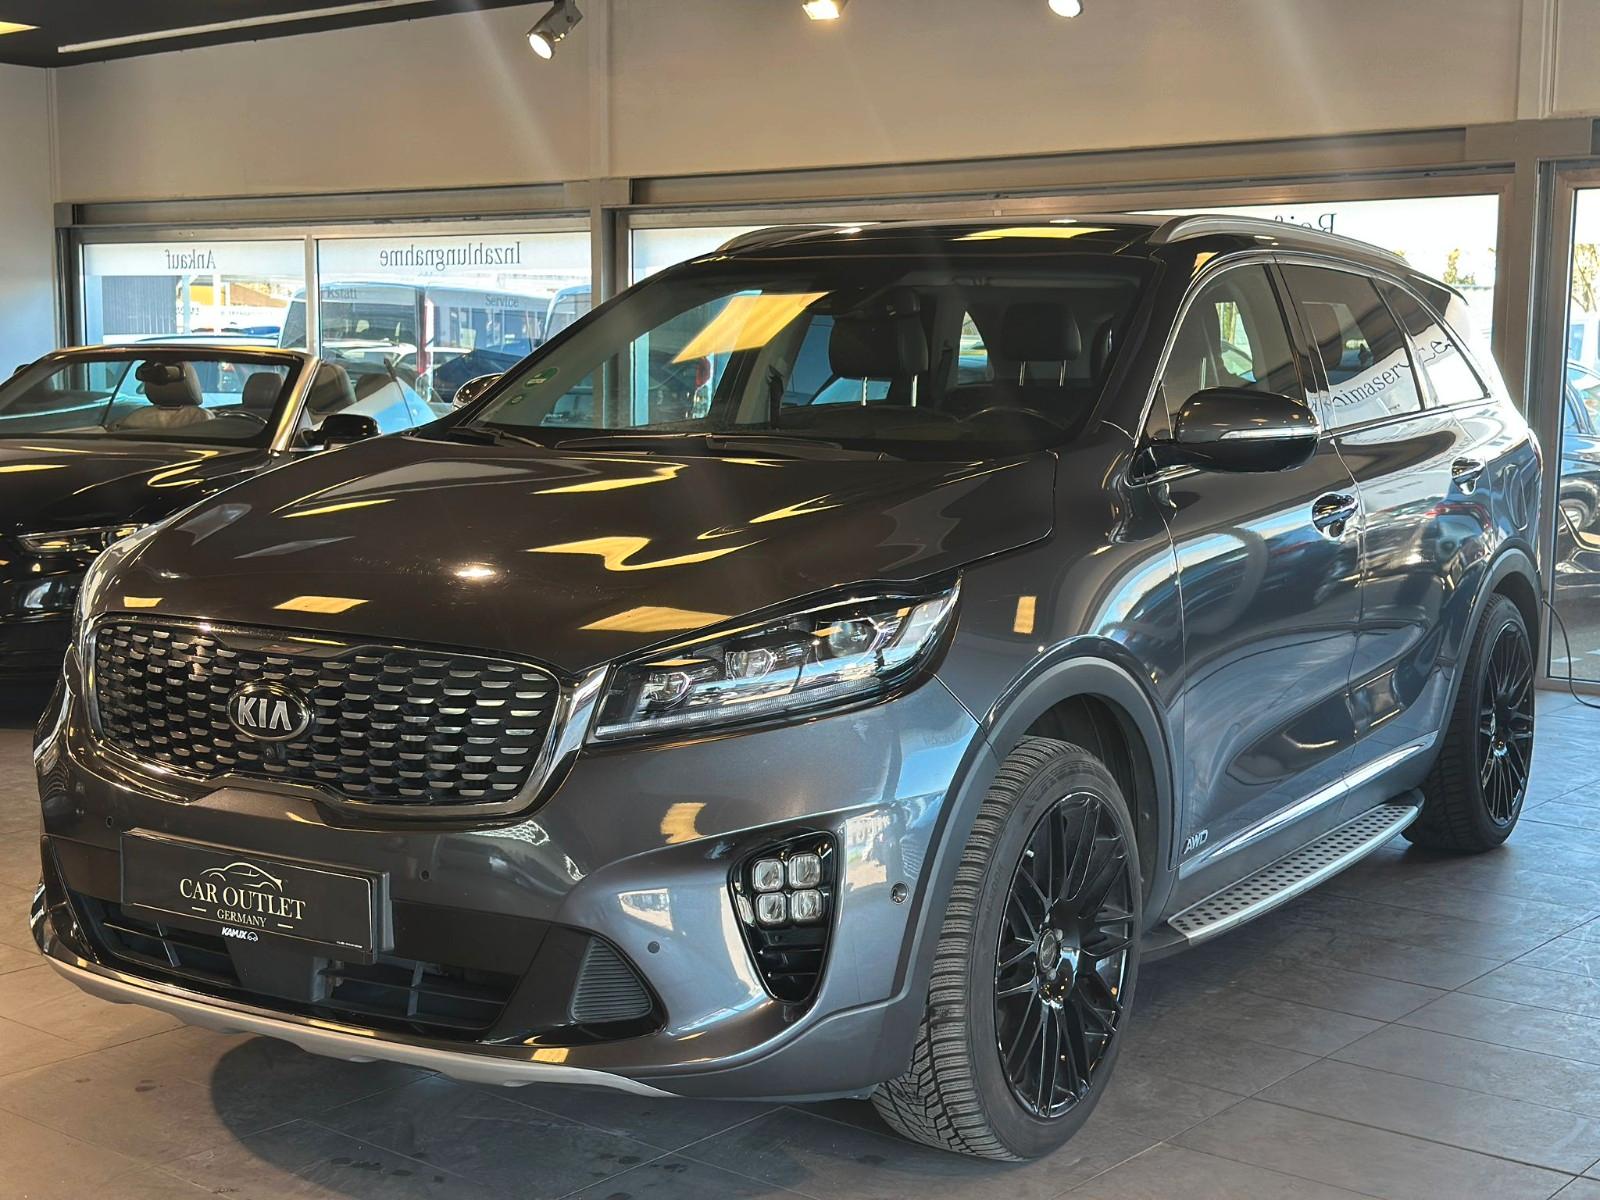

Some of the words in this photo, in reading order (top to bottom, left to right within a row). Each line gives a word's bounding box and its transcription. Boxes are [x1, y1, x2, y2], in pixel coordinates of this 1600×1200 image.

[485, 293, 520, 308] Service
[237, 695, 293, 731] KIA
[1184, 829, 1209, 854] AWD
[179, 878, 218, 903] CAR
[223, 887, 306, 920] OUTLET
[217, 909, 268, 928] GERMANY
[221, 926, 248, 940] KAMUX
